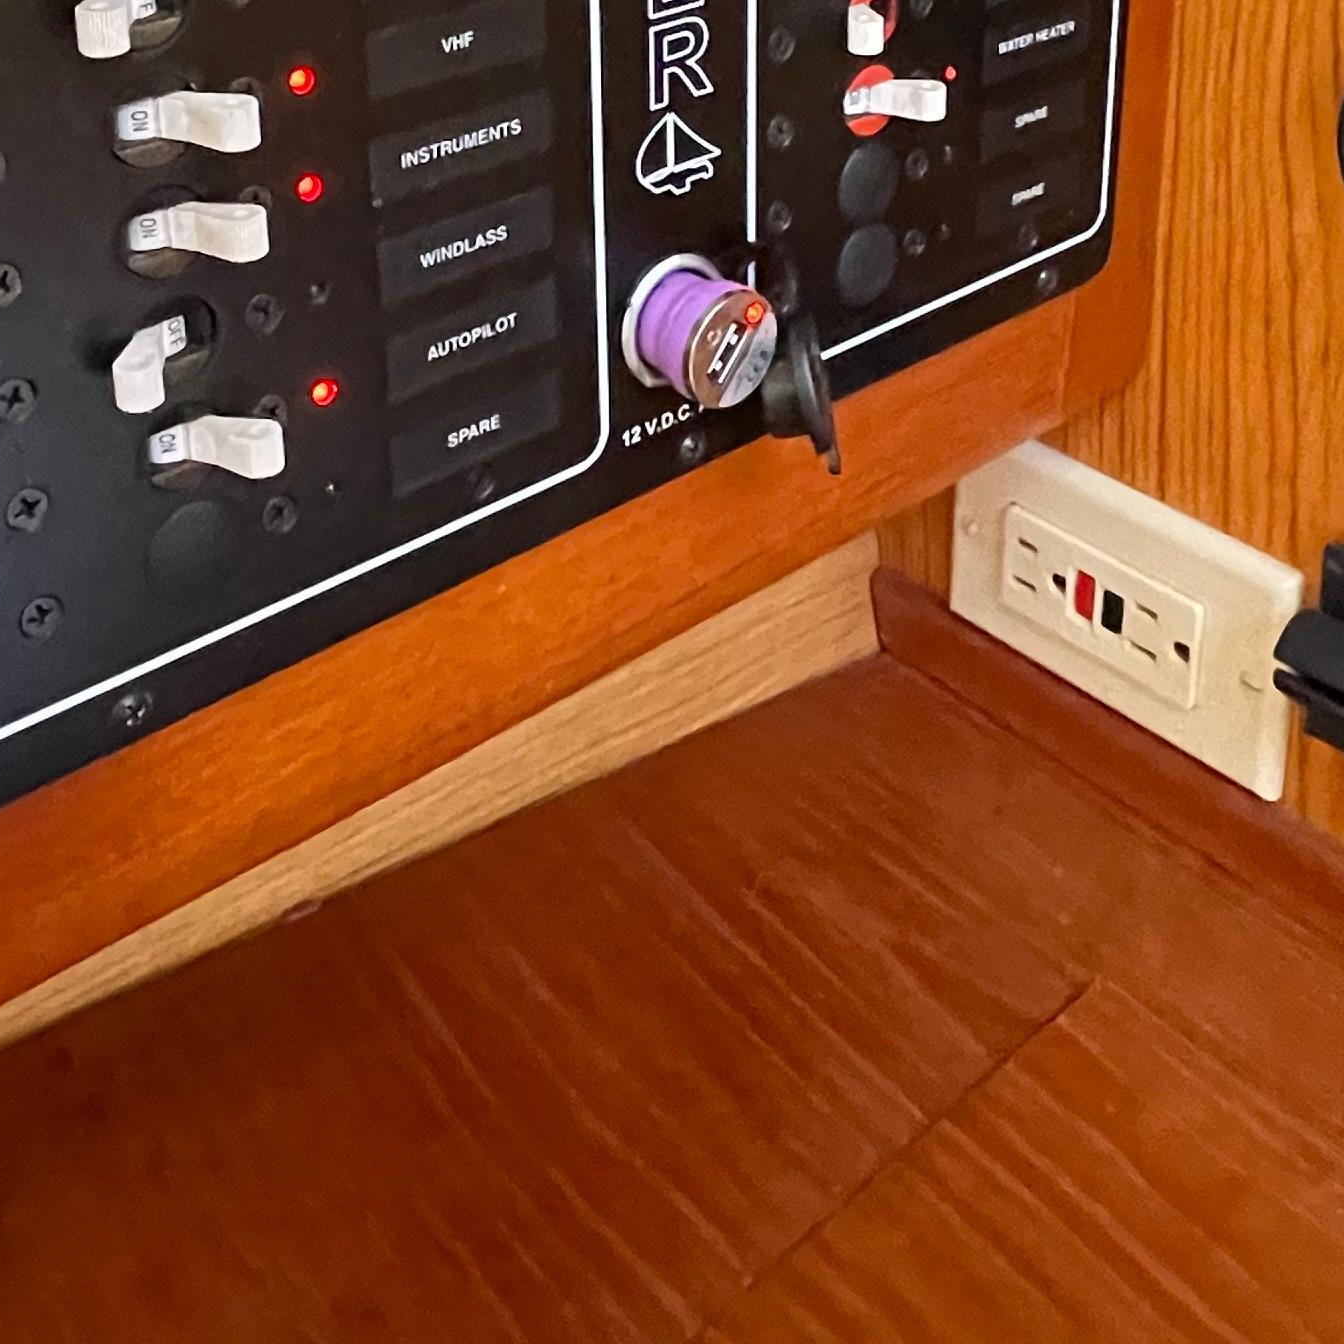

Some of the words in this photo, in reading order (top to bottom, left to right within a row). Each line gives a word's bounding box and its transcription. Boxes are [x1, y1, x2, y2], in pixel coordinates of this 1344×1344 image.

[441, 31, 475, 53] VHF
[130, 110, 148, 133] ON
[400, 117, 523, 170] INSTRUMENTS
[139, 217, 158, 241] ON
[419, 225, 509, 269] WINDLASS
[427, 311, 519, 362] AUTOPILOT
[446, 414, 502, 449] SPARE
[622, 424, 643, 447] 12
